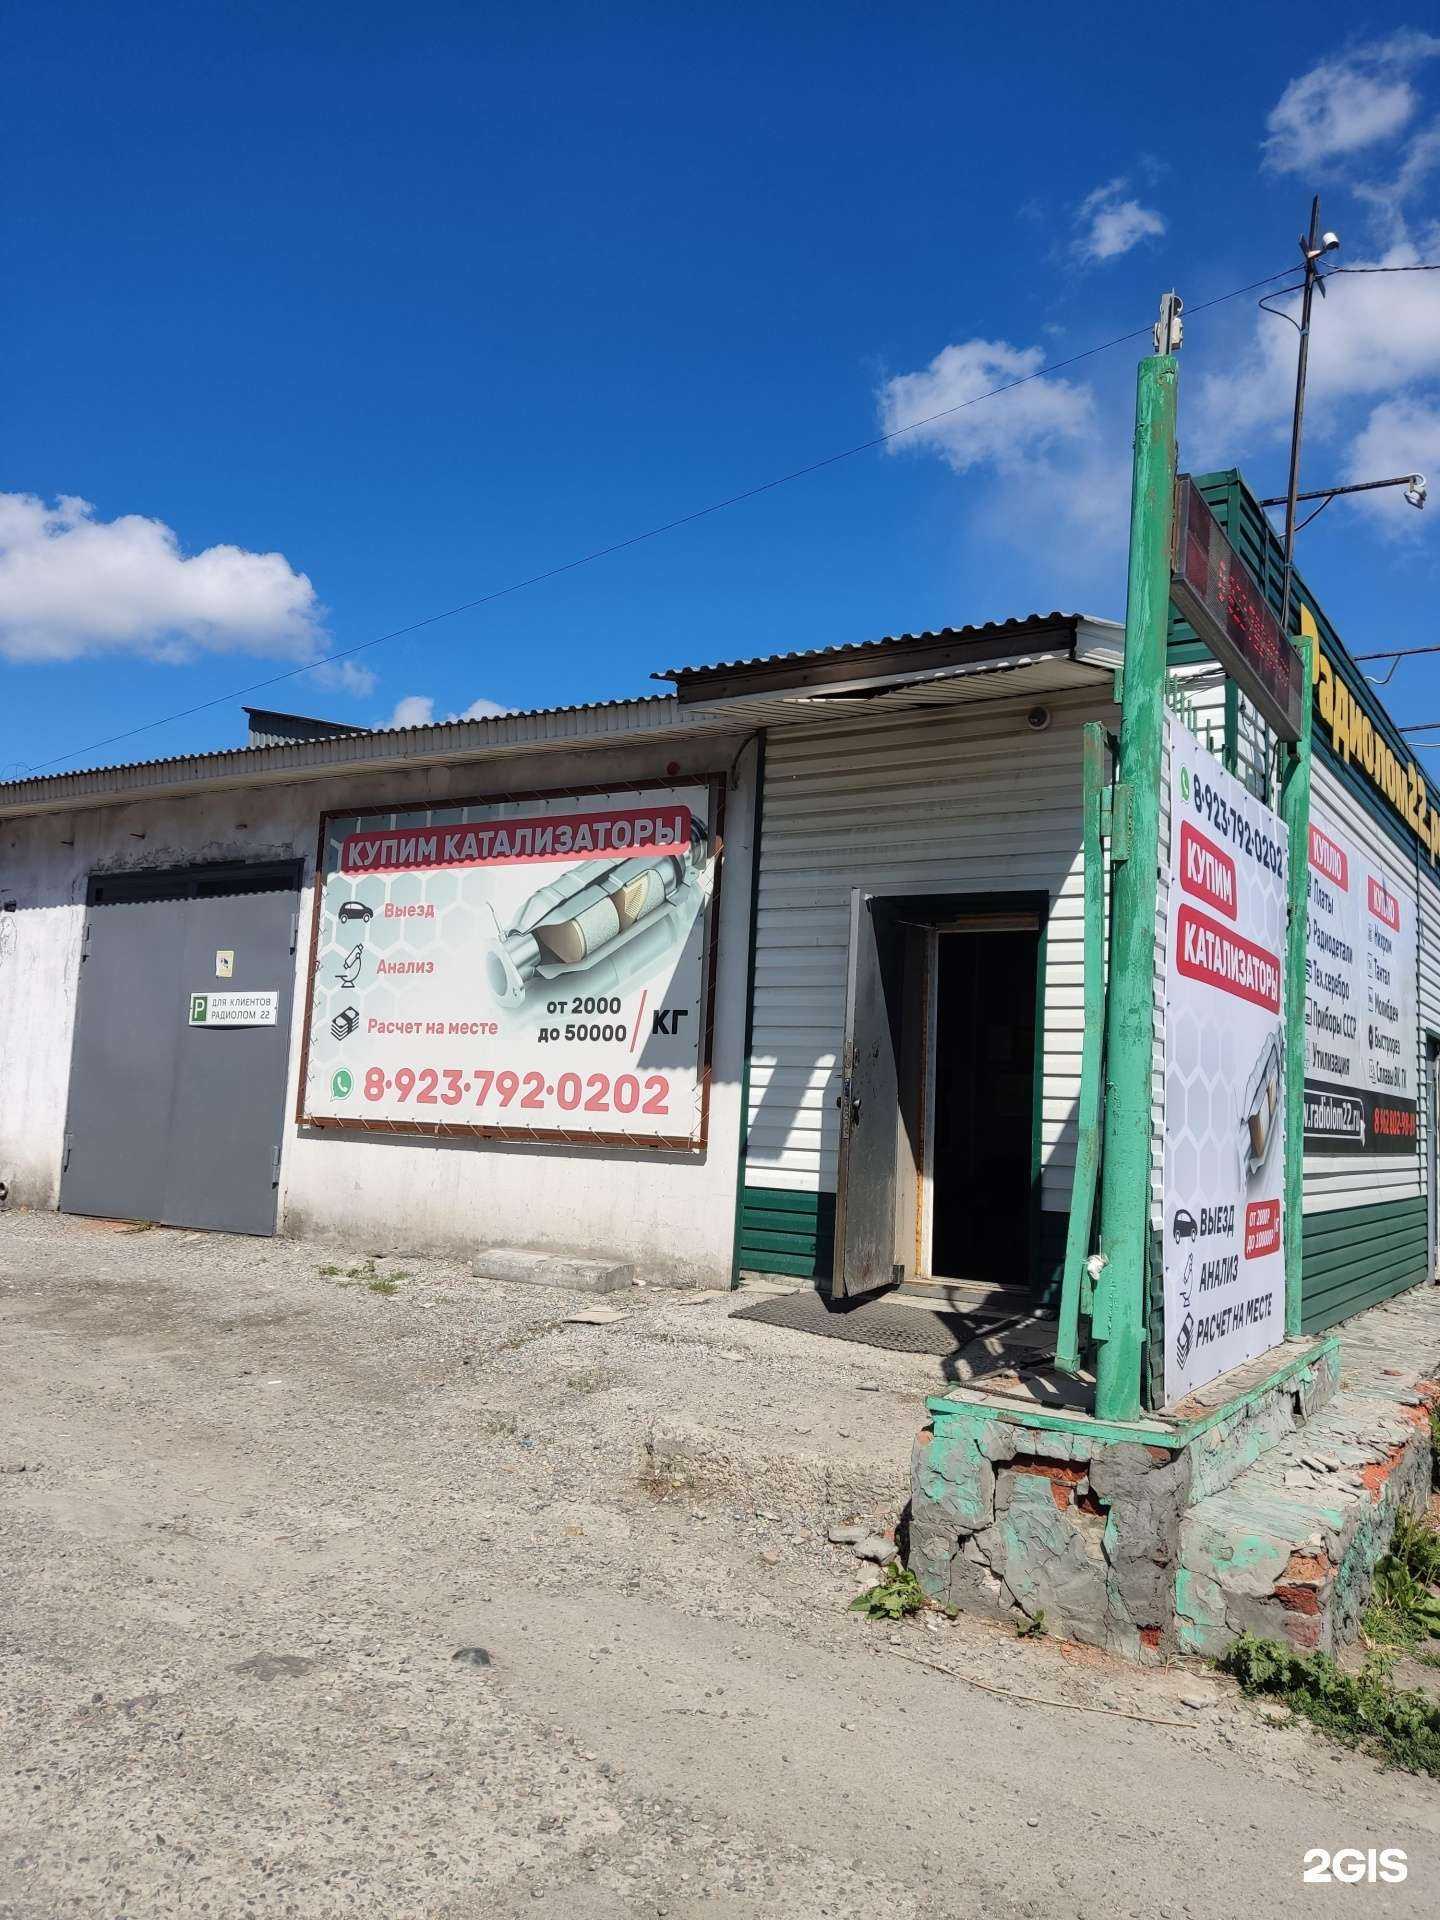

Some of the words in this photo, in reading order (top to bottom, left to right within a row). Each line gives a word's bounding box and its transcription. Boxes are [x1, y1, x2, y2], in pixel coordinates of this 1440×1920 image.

[348, 833, 437, 868] КУПИМ
[444, 816, 683, 860] КАТАЛИЗАТОРЫ
[1313, 831, 1342, 881] КУПЛЮ
[1187, 837, 1233, 906] КУПИМ
[384, 902, 435, 919] Выезд
[1314, 878, 1334, 915] Платы
[1313, 918, 1353, 964] Радиодетали
[376, 959, 434, 976] Анализ
[1184, 920, 1279, 1003] КАТАЛИЗАТОРЫ
[1313, 960, 1350, 1005] Тех.серебро
[211, 1010, 256, 1020] РАДИОЛОМ
[260, 1010, 270, 1020] 22
[212, 999, 227, 1007] ДЛЯ
[230, 998, 271, 1007] КЛИЕНТОВ
[547, 1001, 567, 1014] от
[571, 997, 621, 1015] 2000
[1313, 1001, 1342, 1040] Приборы
[1342, 1013, 1357, 1040] СССР
[368, 1019, 424, 1036] Расчет
[426, 1022, 446, 1036] на
[449, 1021, 498, 1036] месте
[538, 1026, 560, 1043] до
[564, 1024, 627, 1043] 50000
[652, 1009, 689, 1035] КГ
[1312, 1042, 1350, 1077] Утилизация
[1200, 1205, 1235, 1238] ВЫЕЗД
[1199, 1254, 1239, 1292] АНАЛИЗ
[1196, 1307, 1232, 1348] РАСЧЕТ
[1232, 1303, 1244, 1331] НА
[1245, 1292, 1273, 1325] МЕСТЕ
